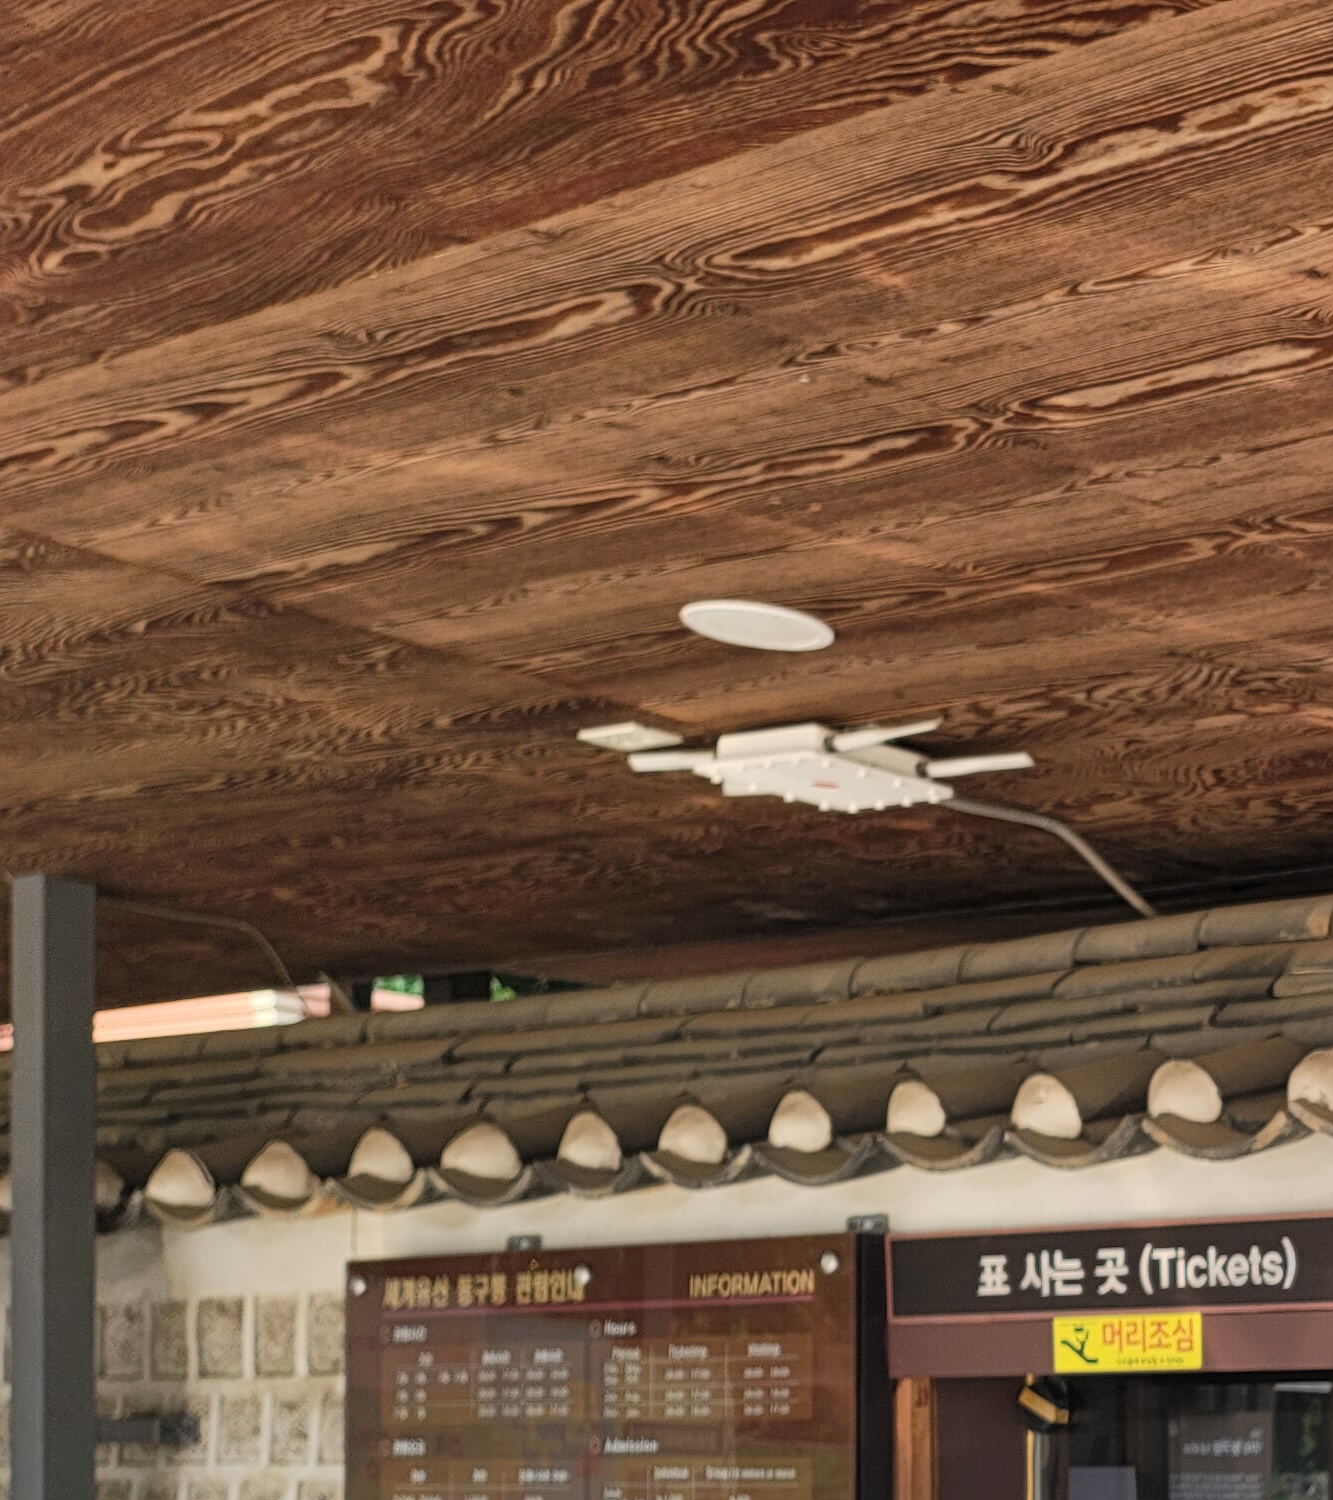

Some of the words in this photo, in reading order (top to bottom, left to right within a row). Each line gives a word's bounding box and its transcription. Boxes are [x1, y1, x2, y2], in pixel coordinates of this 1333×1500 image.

[977, 1255, 1011, 1297] 표
[1020, 1249, 1085, 1297] 사는
[1094, 1247, 1129, 1294] 곳
[1139, 1236, 1297, 1295] (Tickets)
[689, 1269, 815, 1299] INFORMATION
[1102, 1319, 1195, 1353] 머리조심
